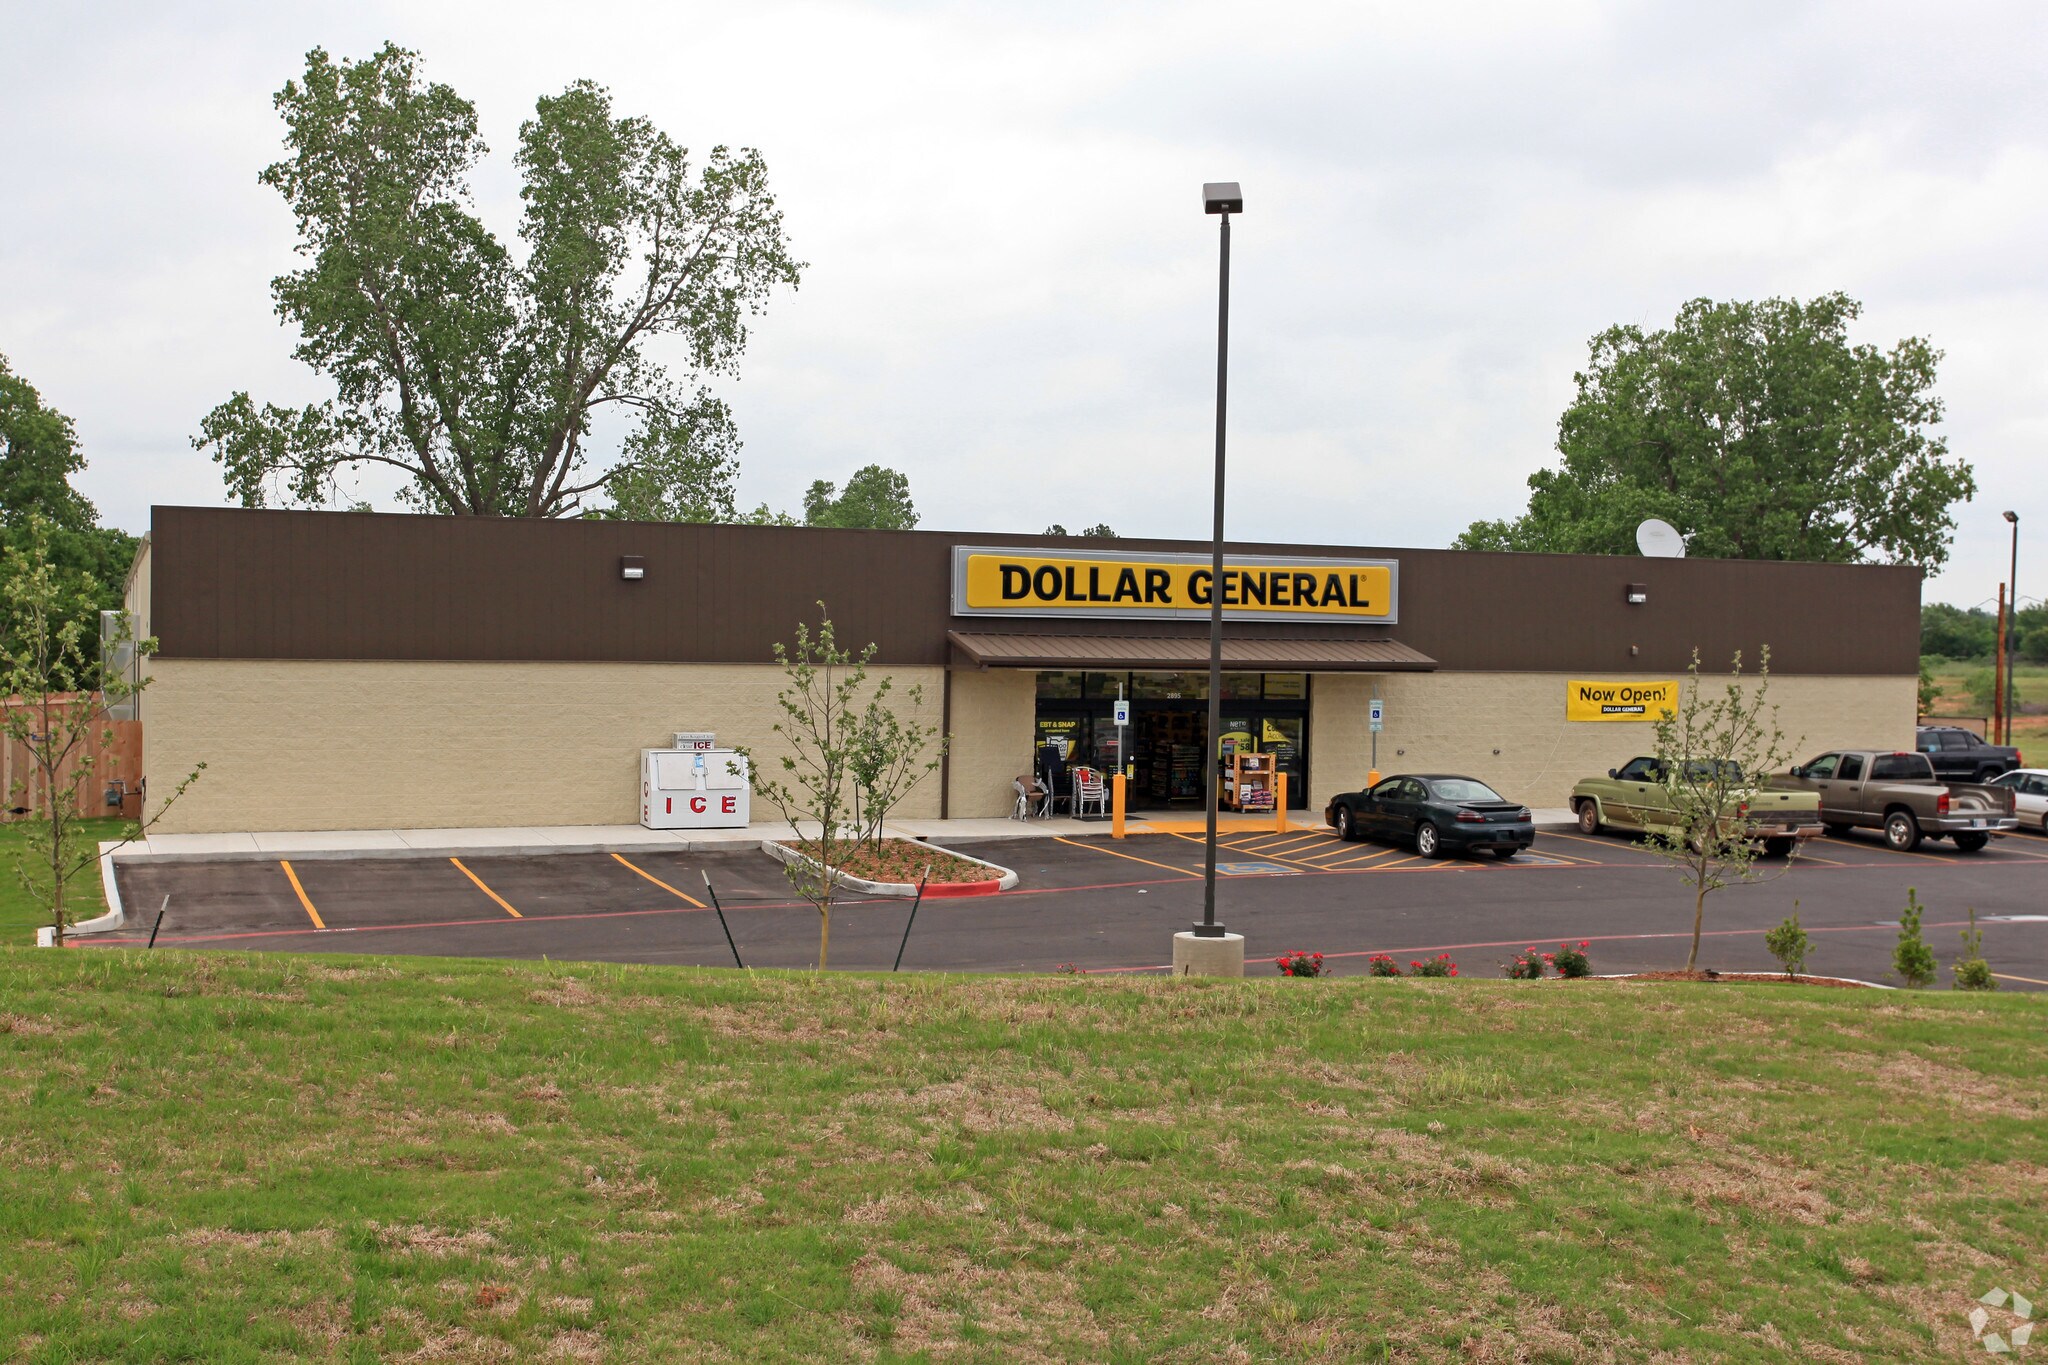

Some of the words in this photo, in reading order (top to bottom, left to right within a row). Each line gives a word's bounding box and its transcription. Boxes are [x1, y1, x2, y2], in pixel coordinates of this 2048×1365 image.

[1000, 564, 1171, 603] DOLLAR
[1187, 569, 1369, 607] GENERAL
[1580, 687, 1615, 701] Now
[1620, 687, 1666, 704] Open!
[693, 741, 711, 749] ICE
[666, 796, 736, 814] ICE
